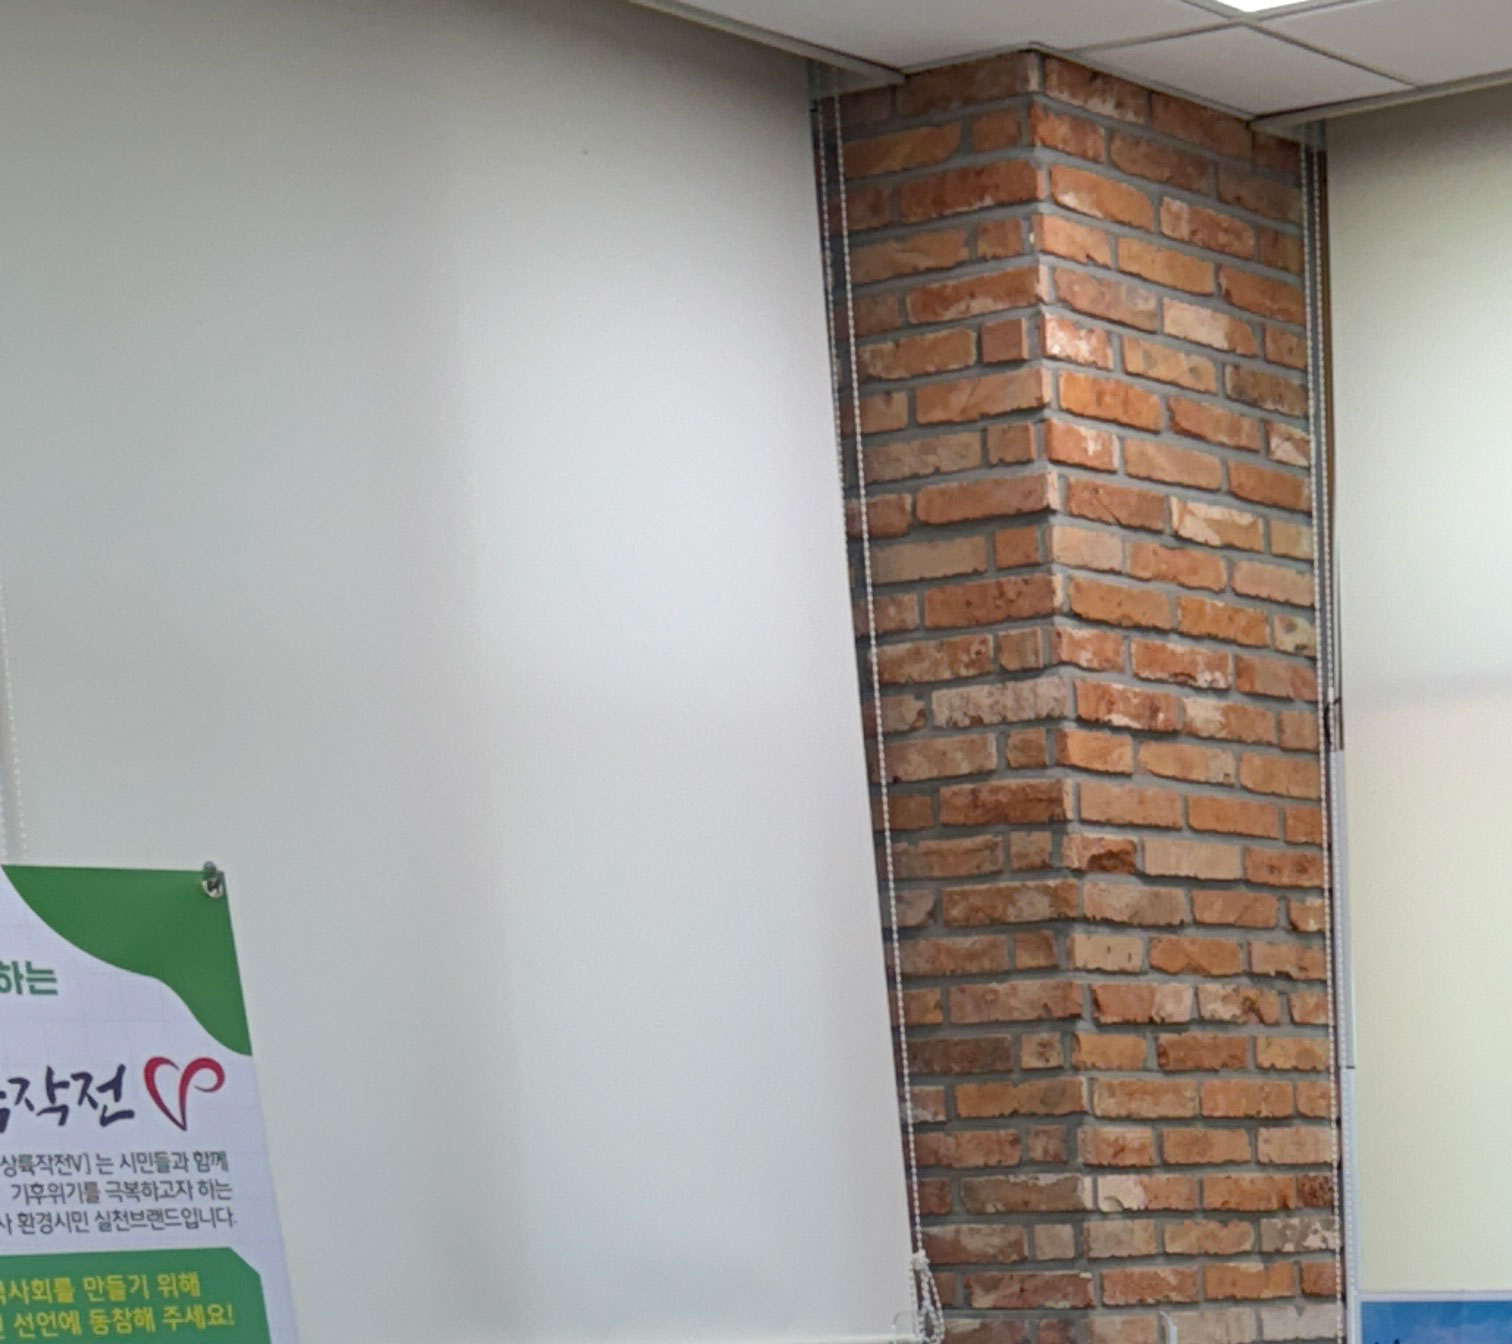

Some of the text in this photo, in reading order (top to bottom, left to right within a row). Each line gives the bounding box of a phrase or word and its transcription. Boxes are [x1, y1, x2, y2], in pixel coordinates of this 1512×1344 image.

[0, 1063, 135, 1134] 작전
[120, 1150, 189, 1174] 시민들과
[193, 1150, 229, 1172] 함께
[11, 1179, 233, 1205] 기후위기를 극복하고자 하는
[17, 1210, 90, 1236] 환경시민
[0, 1271, 201, 1306] 사회를 만들기 위해
[14, 1310, 82, 1339] 선언에
[89, 1306, 156, 1336] 동참해
[163, 1303, 235, 1331] 주세요!
